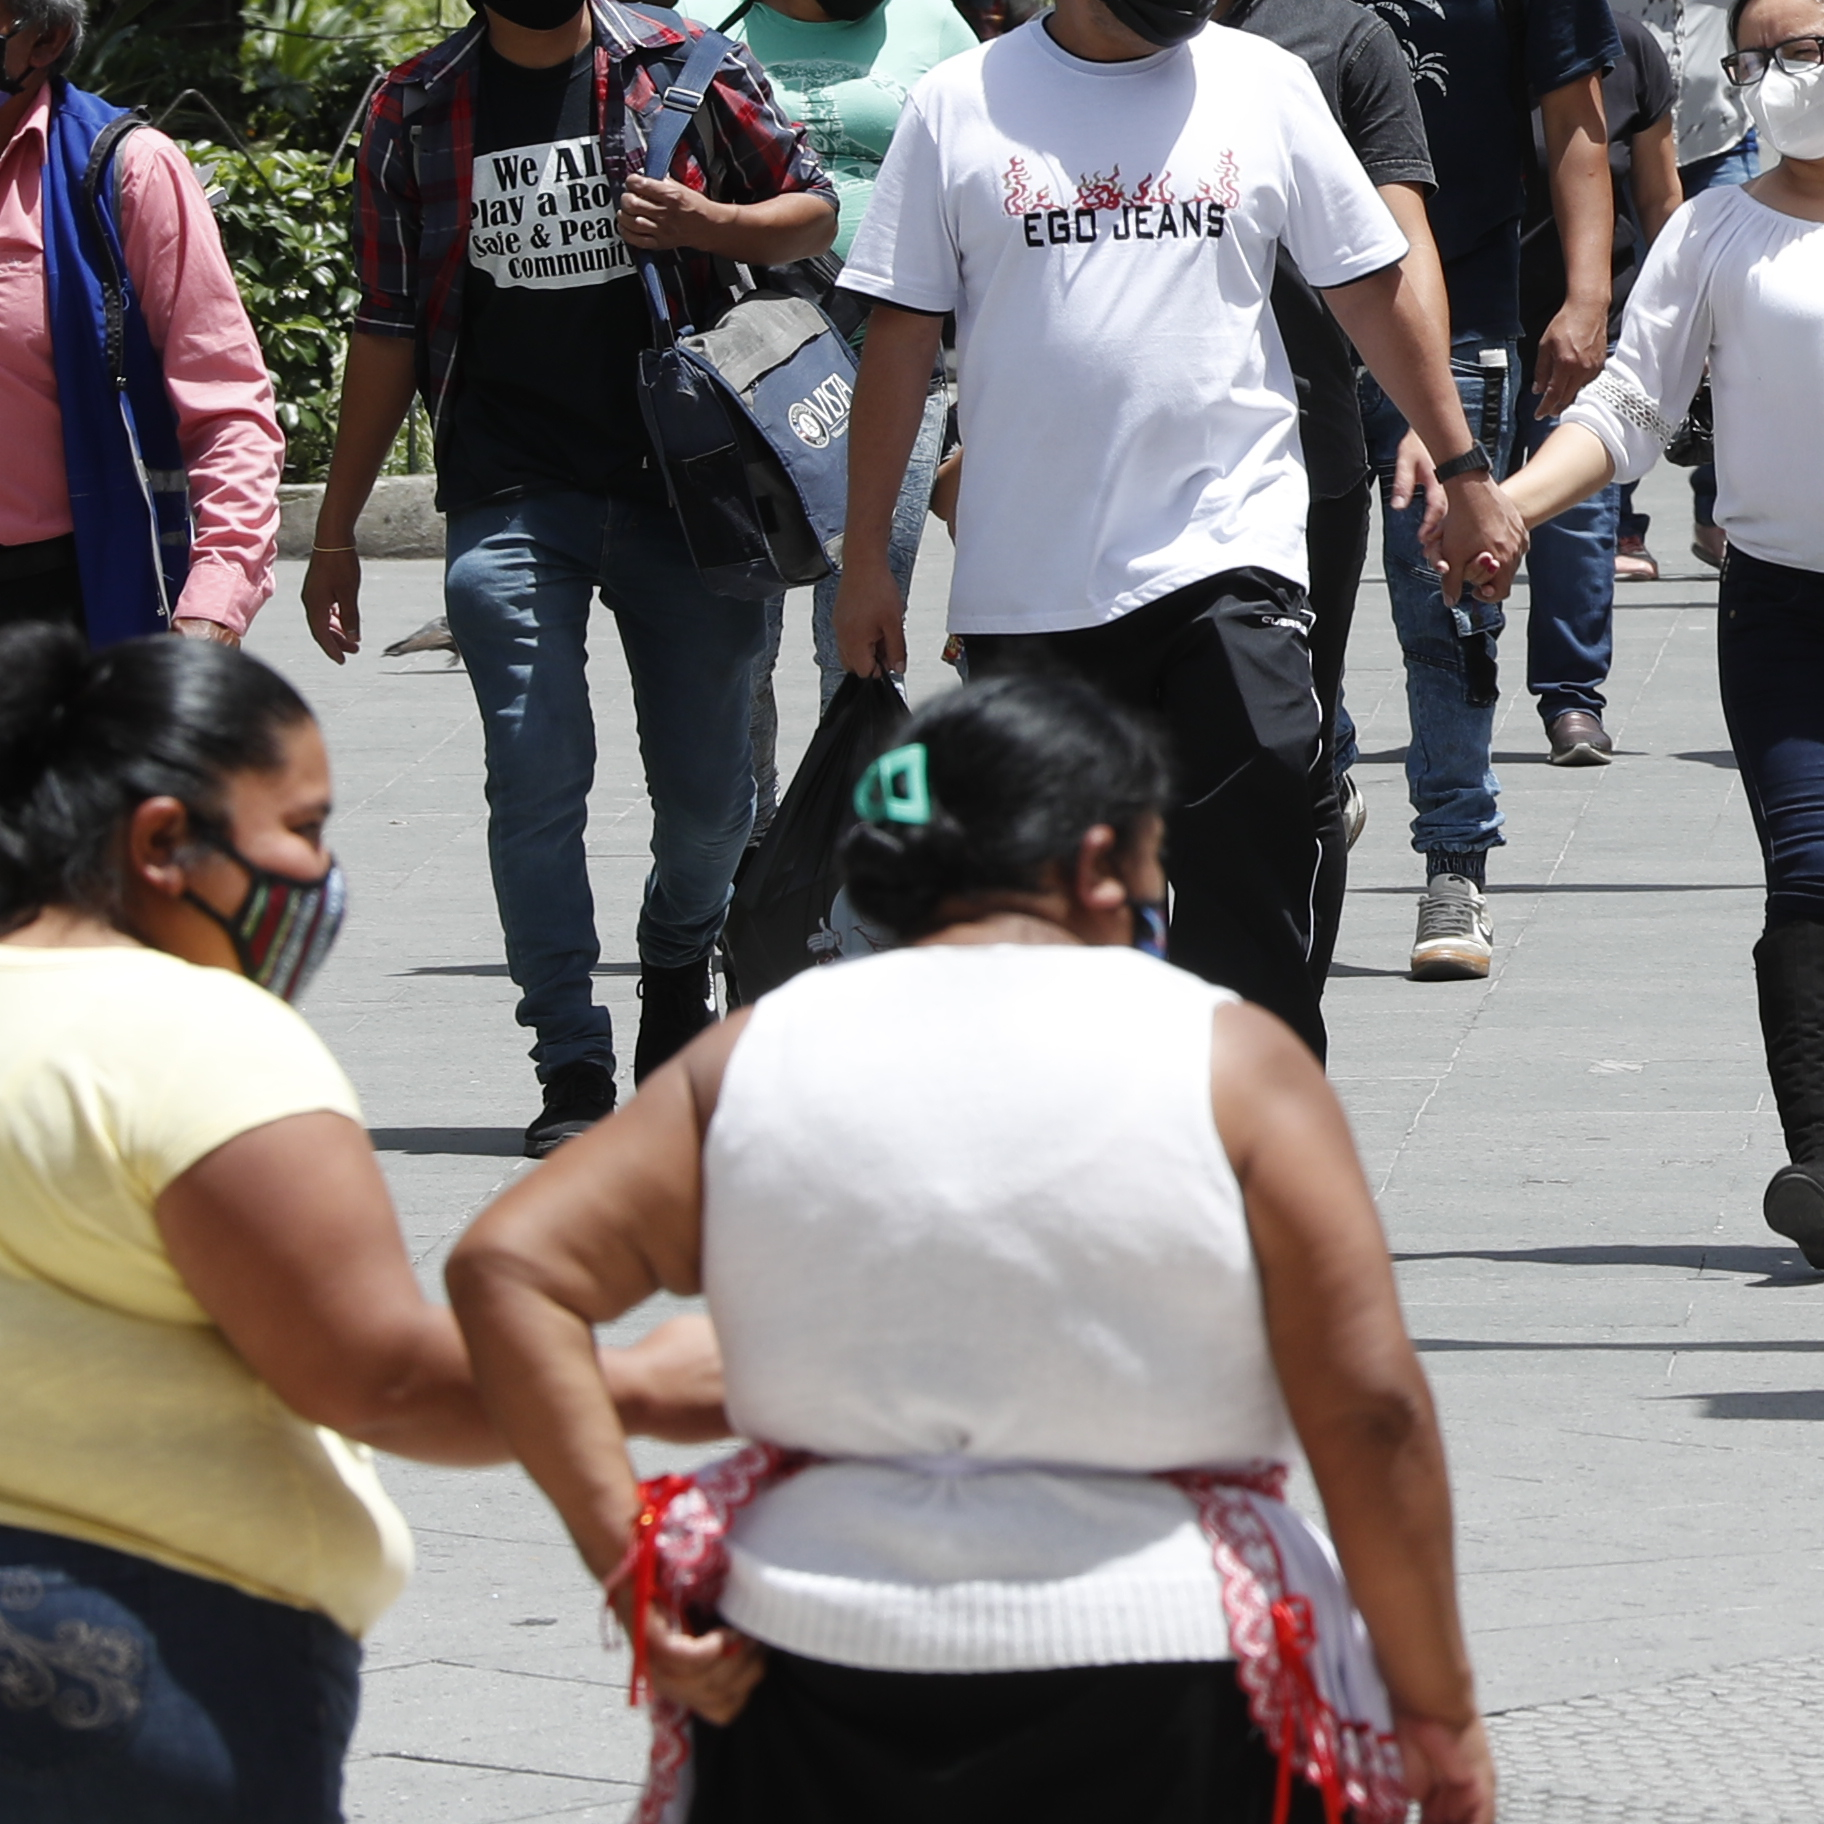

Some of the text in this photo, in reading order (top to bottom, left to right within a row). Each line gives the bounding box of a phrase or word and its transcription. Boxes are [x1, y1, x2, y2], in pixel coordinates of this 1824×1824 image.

[492, 154, 539, 193] We
[536, 191, 559, 218] a
[529, 222, 552, 250] &
[558, 215, 620, 247] Pea
[1023, 201, 1226, 248] EGO JEANS
[803, 372, 854, 426] VISTA
